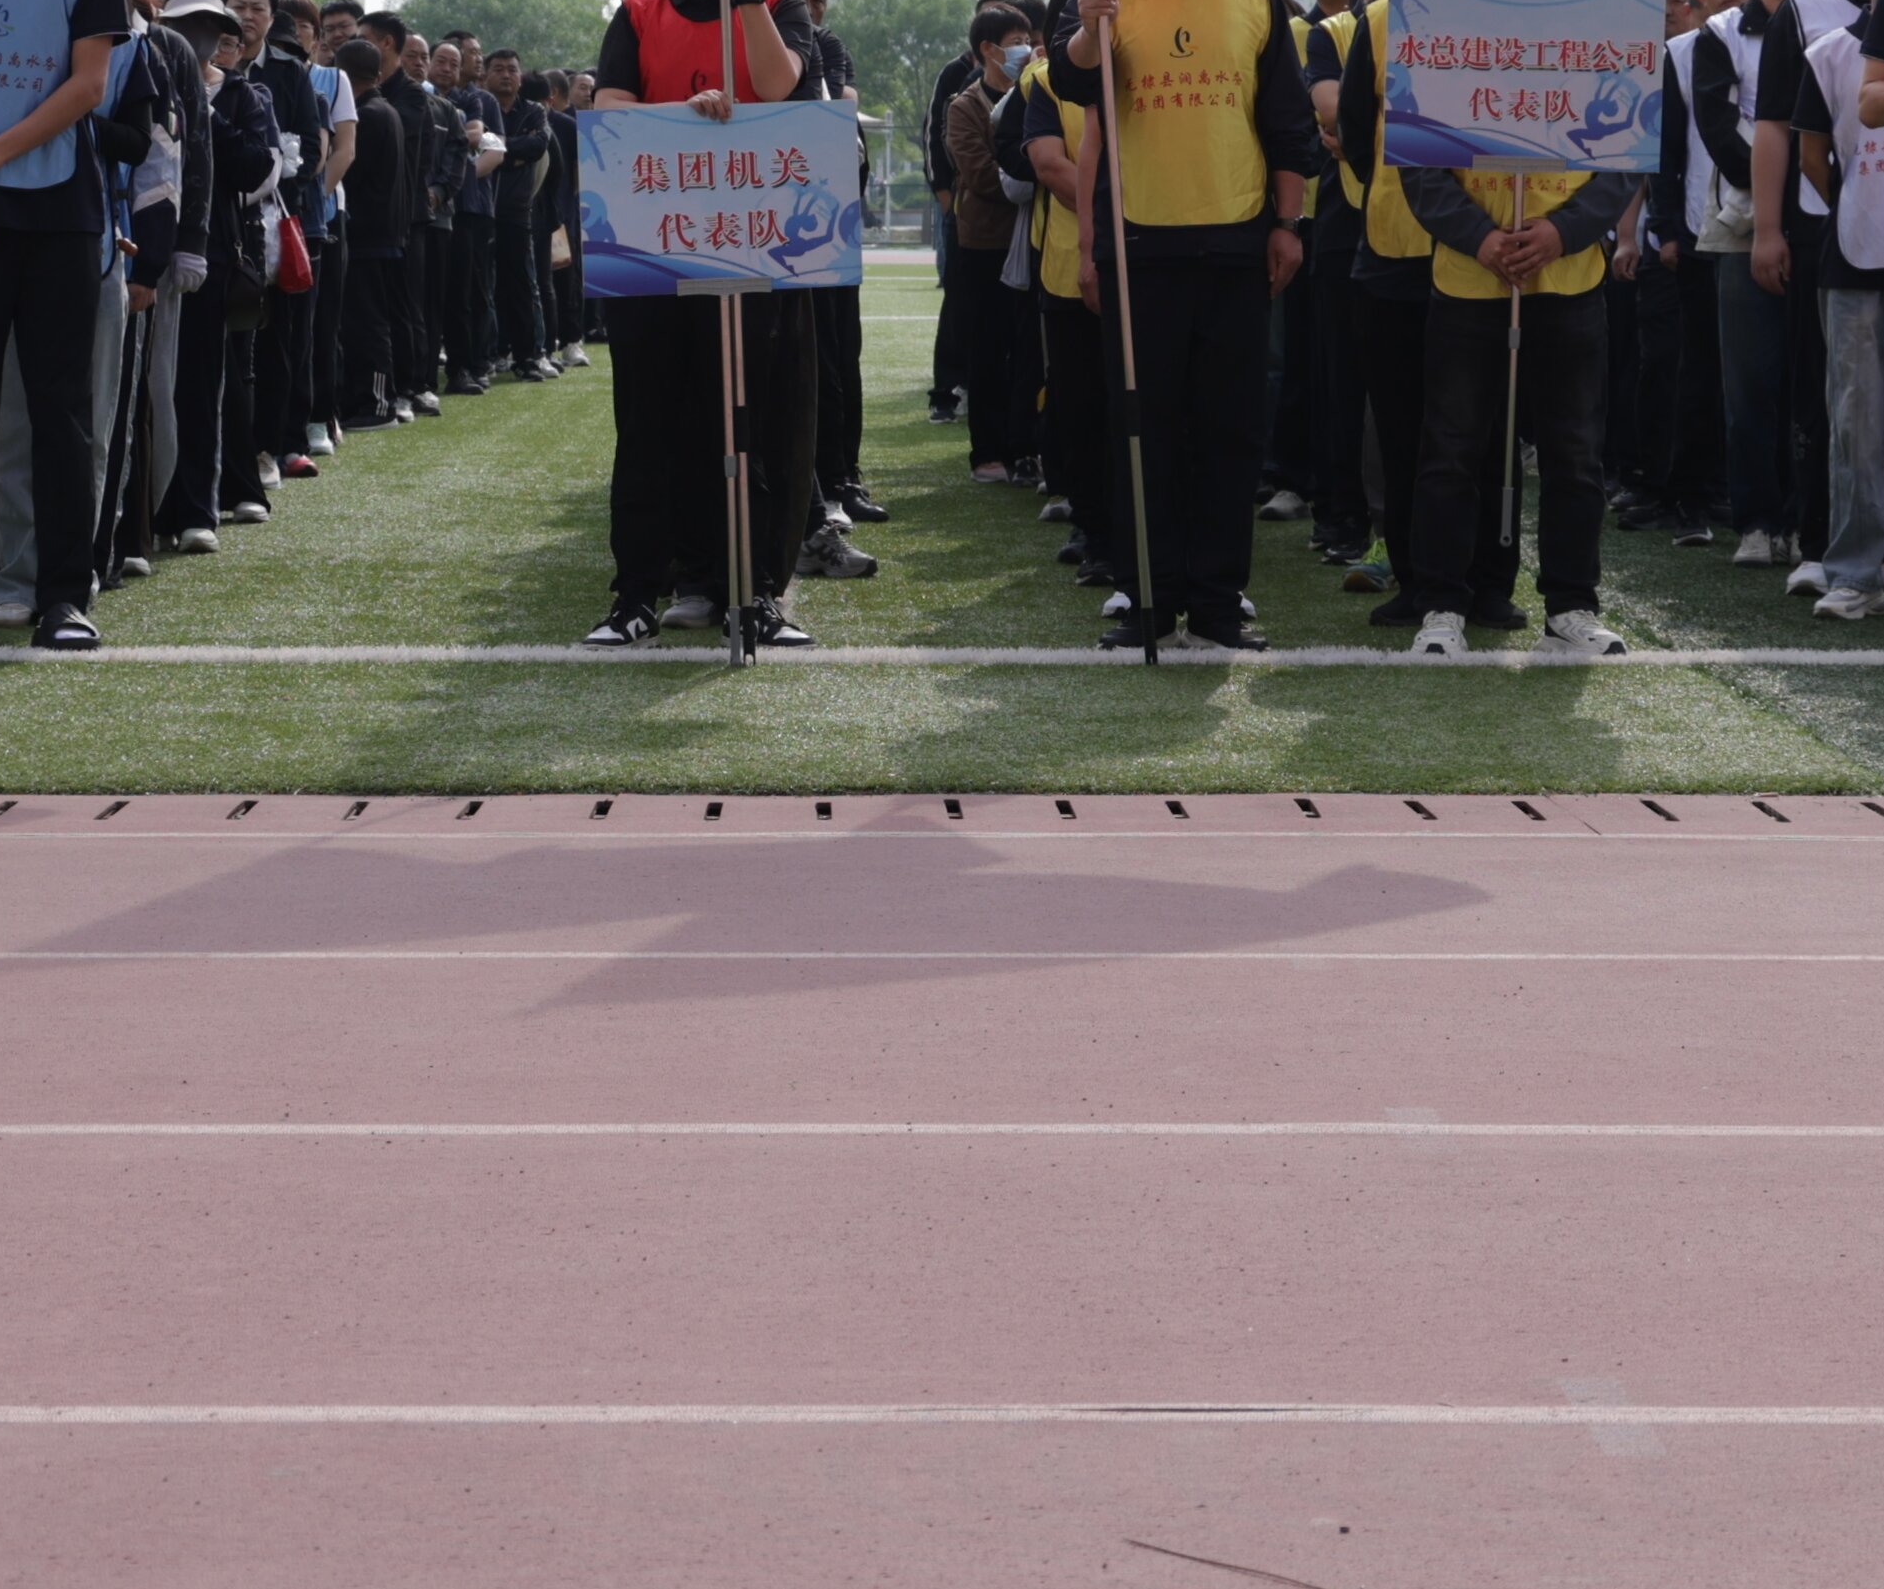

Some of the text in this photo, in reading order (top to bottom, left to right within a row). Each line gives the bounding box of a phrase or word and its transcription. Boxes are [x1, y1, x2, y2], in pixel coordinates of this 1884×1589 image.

[1395, 35, 1657, 74] 水总建设工程公司
[1132, 92, 1236, 114] 集团有限公司
[1469, 87, 1579, 121] 代表队
[631, 147, 810, 192] 集团机关
[657, 209, 790, 252] 代表队
